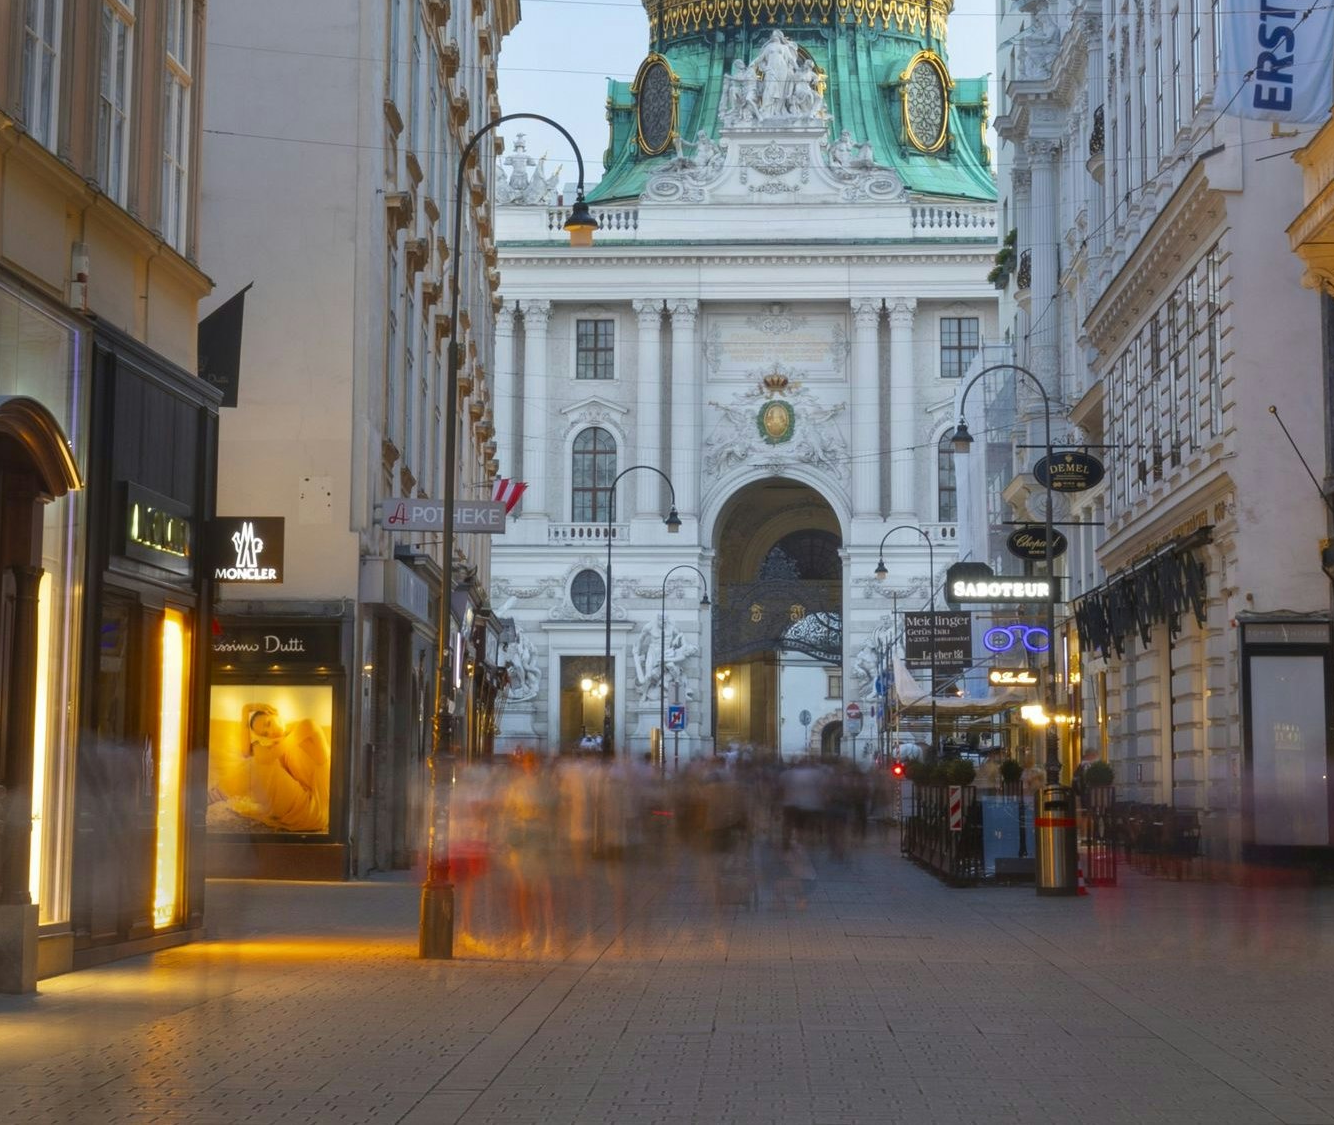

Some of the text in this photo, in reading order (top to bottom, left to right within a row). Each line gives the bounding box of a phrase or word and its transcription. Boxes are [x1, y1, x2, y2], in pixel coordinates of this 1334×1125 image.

[1049, 463, 1090, 474] DEMEL
[388, 502, 500, 526] APOTHEKE
[1013, 534, 1061, 550] Chopad
[214, 568, 277, 580] MONCLER
[212, 635, 305, 653] ssimo Dutti
